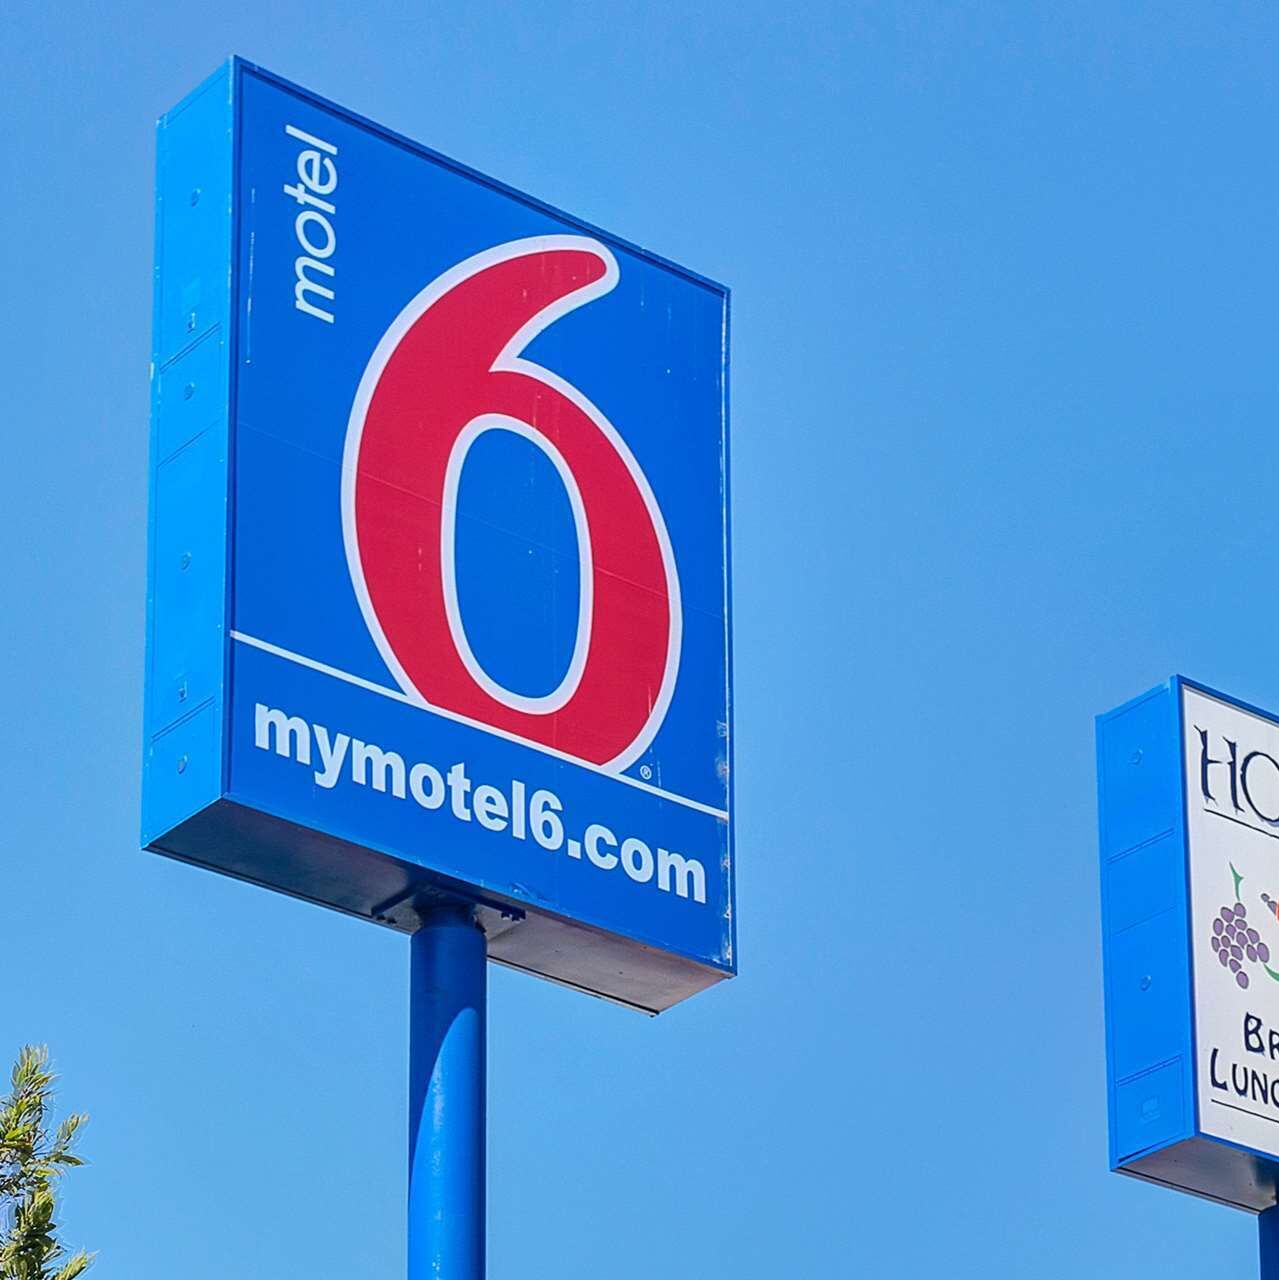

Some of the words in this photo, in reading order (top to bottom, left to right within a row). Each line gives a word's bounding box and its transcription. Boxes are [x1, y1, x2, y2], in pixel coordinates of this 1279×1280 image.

[284, 125, 338, 324] motel
[341, 234, 682, 773] 6
[254, 703, 706, 903] mymotel6.com
